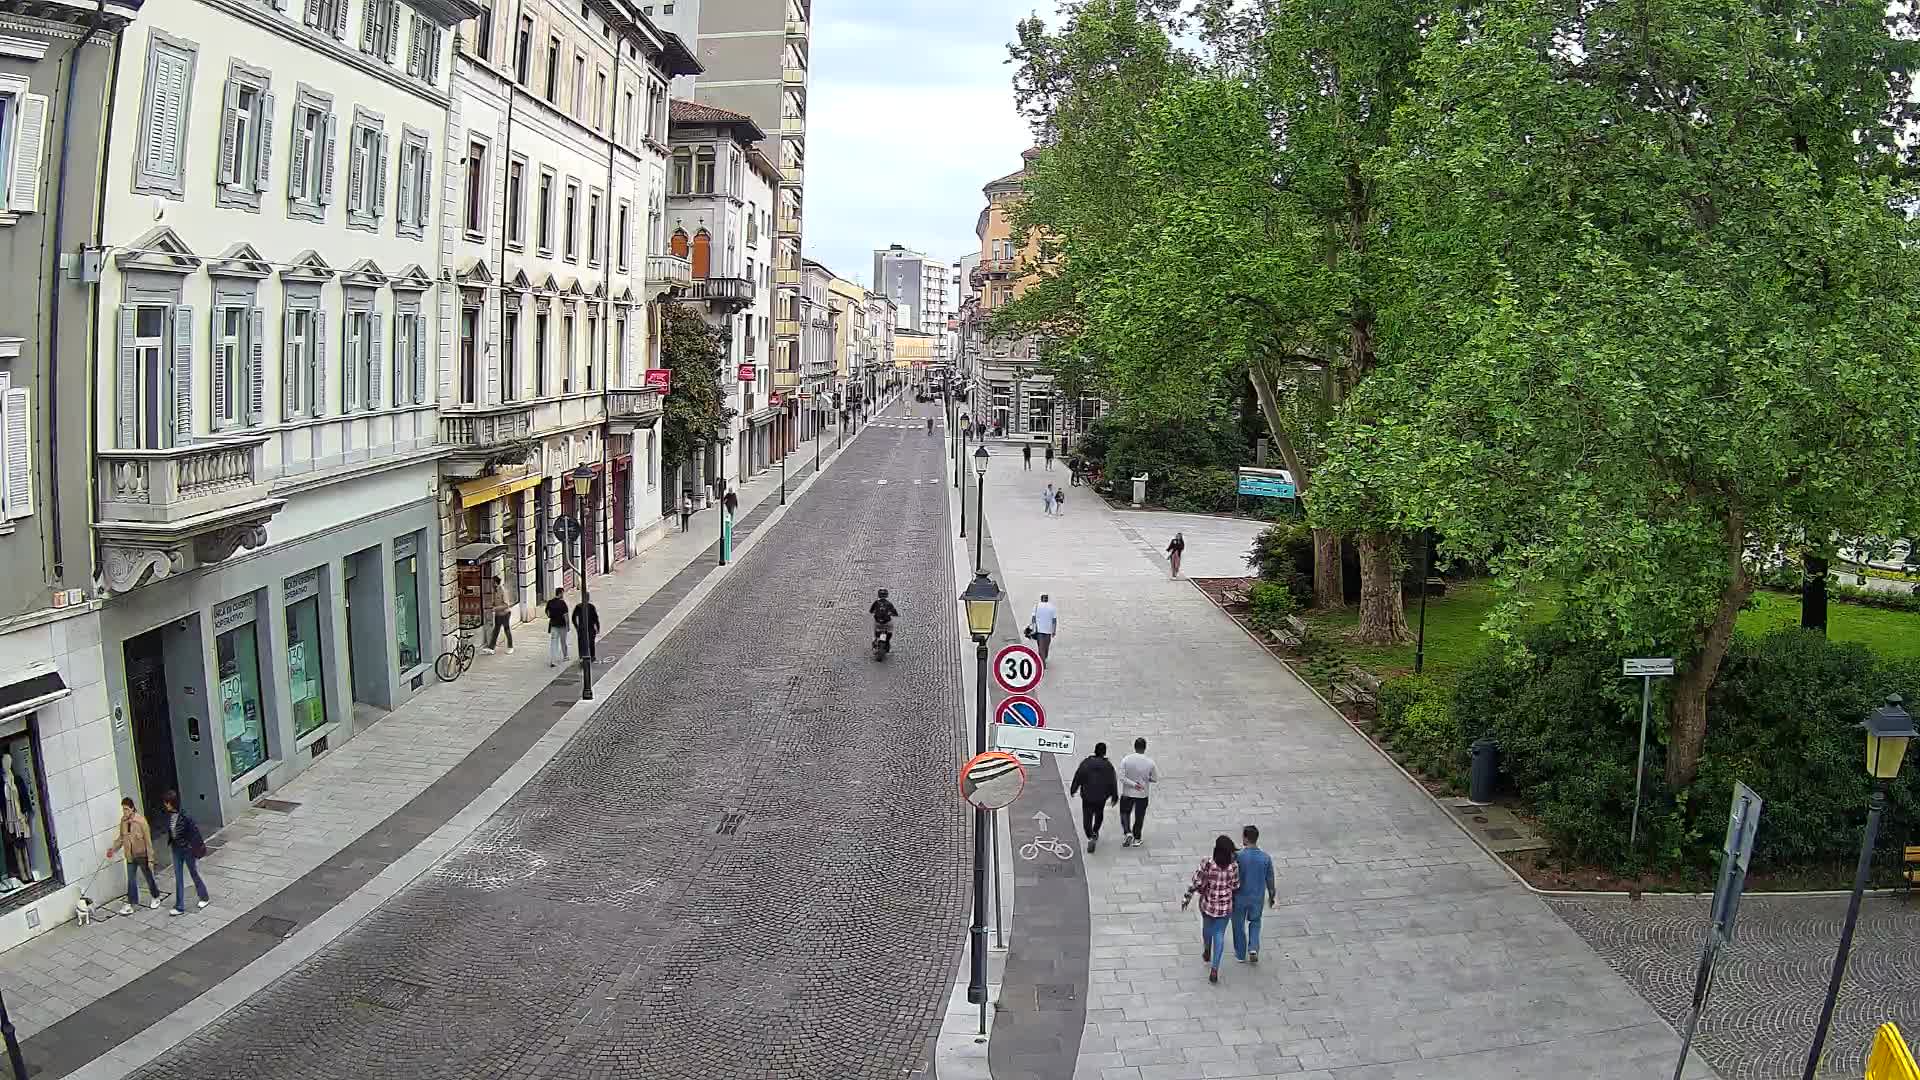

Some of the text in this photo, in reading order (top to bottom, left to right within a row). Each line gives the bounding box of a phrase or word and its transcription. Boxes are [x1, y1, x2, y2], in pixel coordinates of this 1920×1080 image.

[287, 645, 303, 666] 130
[1005, 658, 1033, 680] 30
[222, 677, 240, 700] 130
[1038, 737, 1069, 749] Dante
